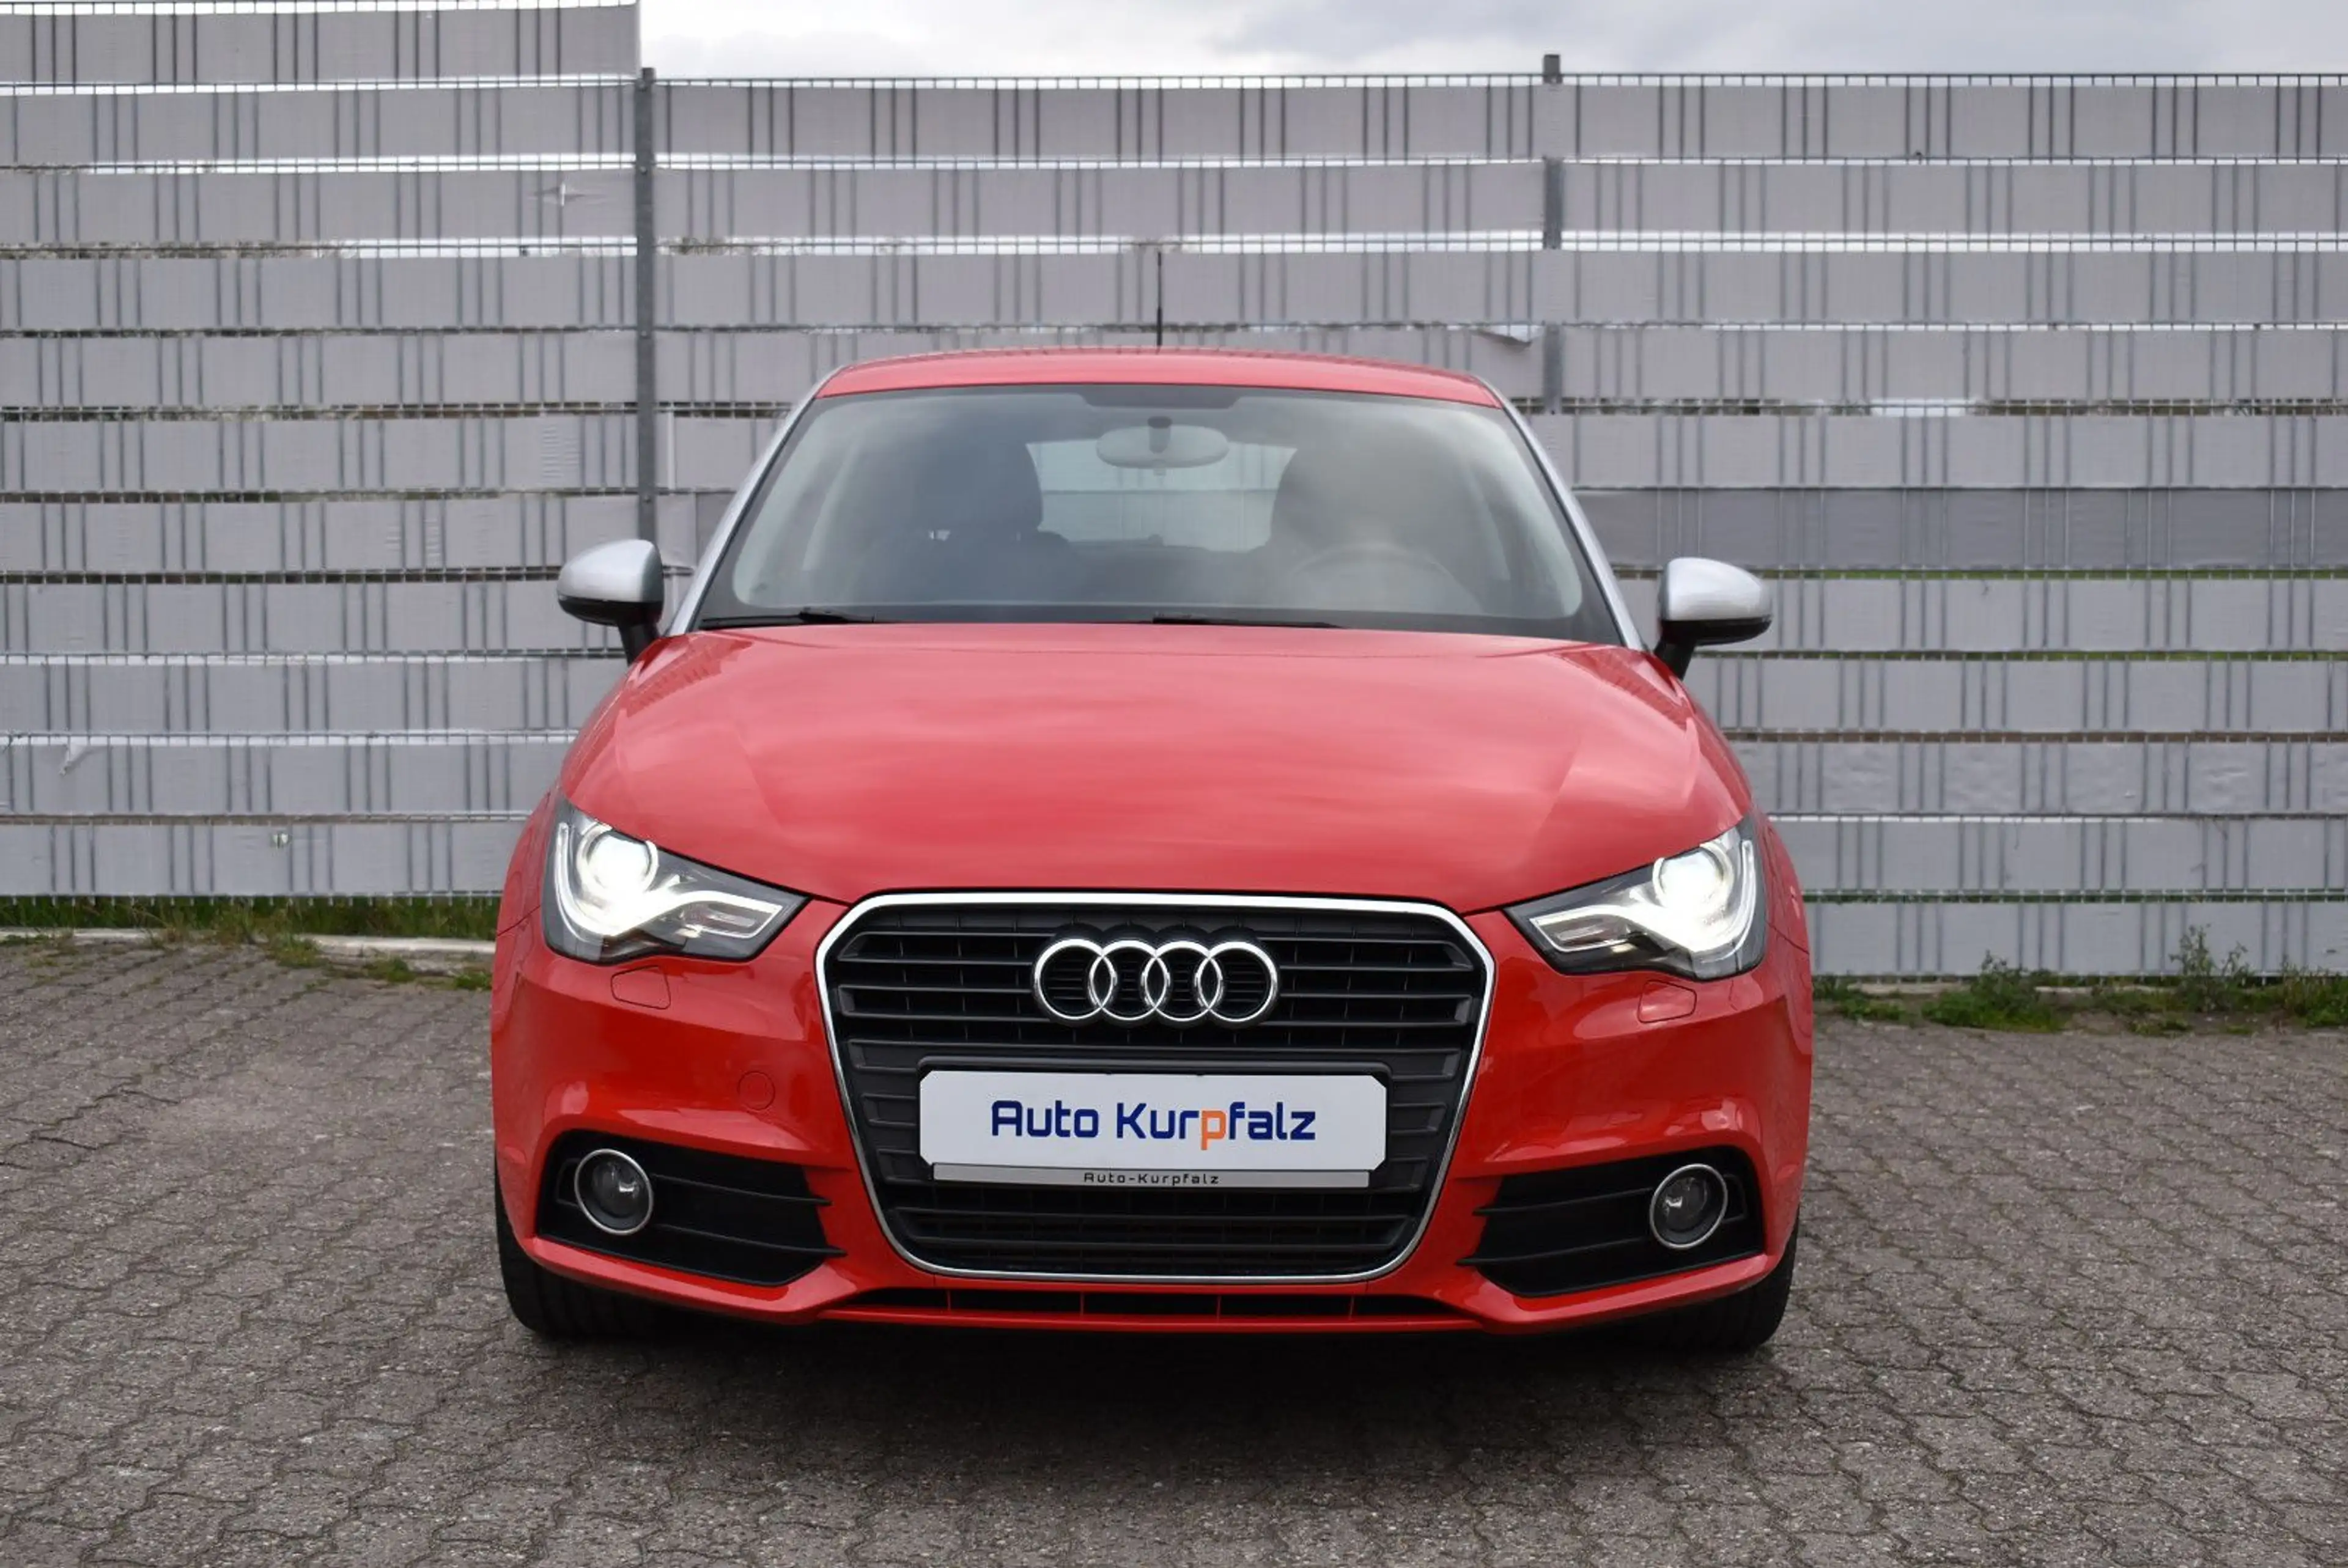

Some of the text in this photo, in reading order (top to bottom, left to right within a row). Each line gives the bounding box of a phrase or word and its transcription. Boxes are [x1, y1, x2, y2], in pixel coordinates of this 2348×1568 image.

[991, 1100, 1316, 1150] Auto Kurpfalz
[1084, 1171, 1220, 1186] Auto-Kurpfalz
